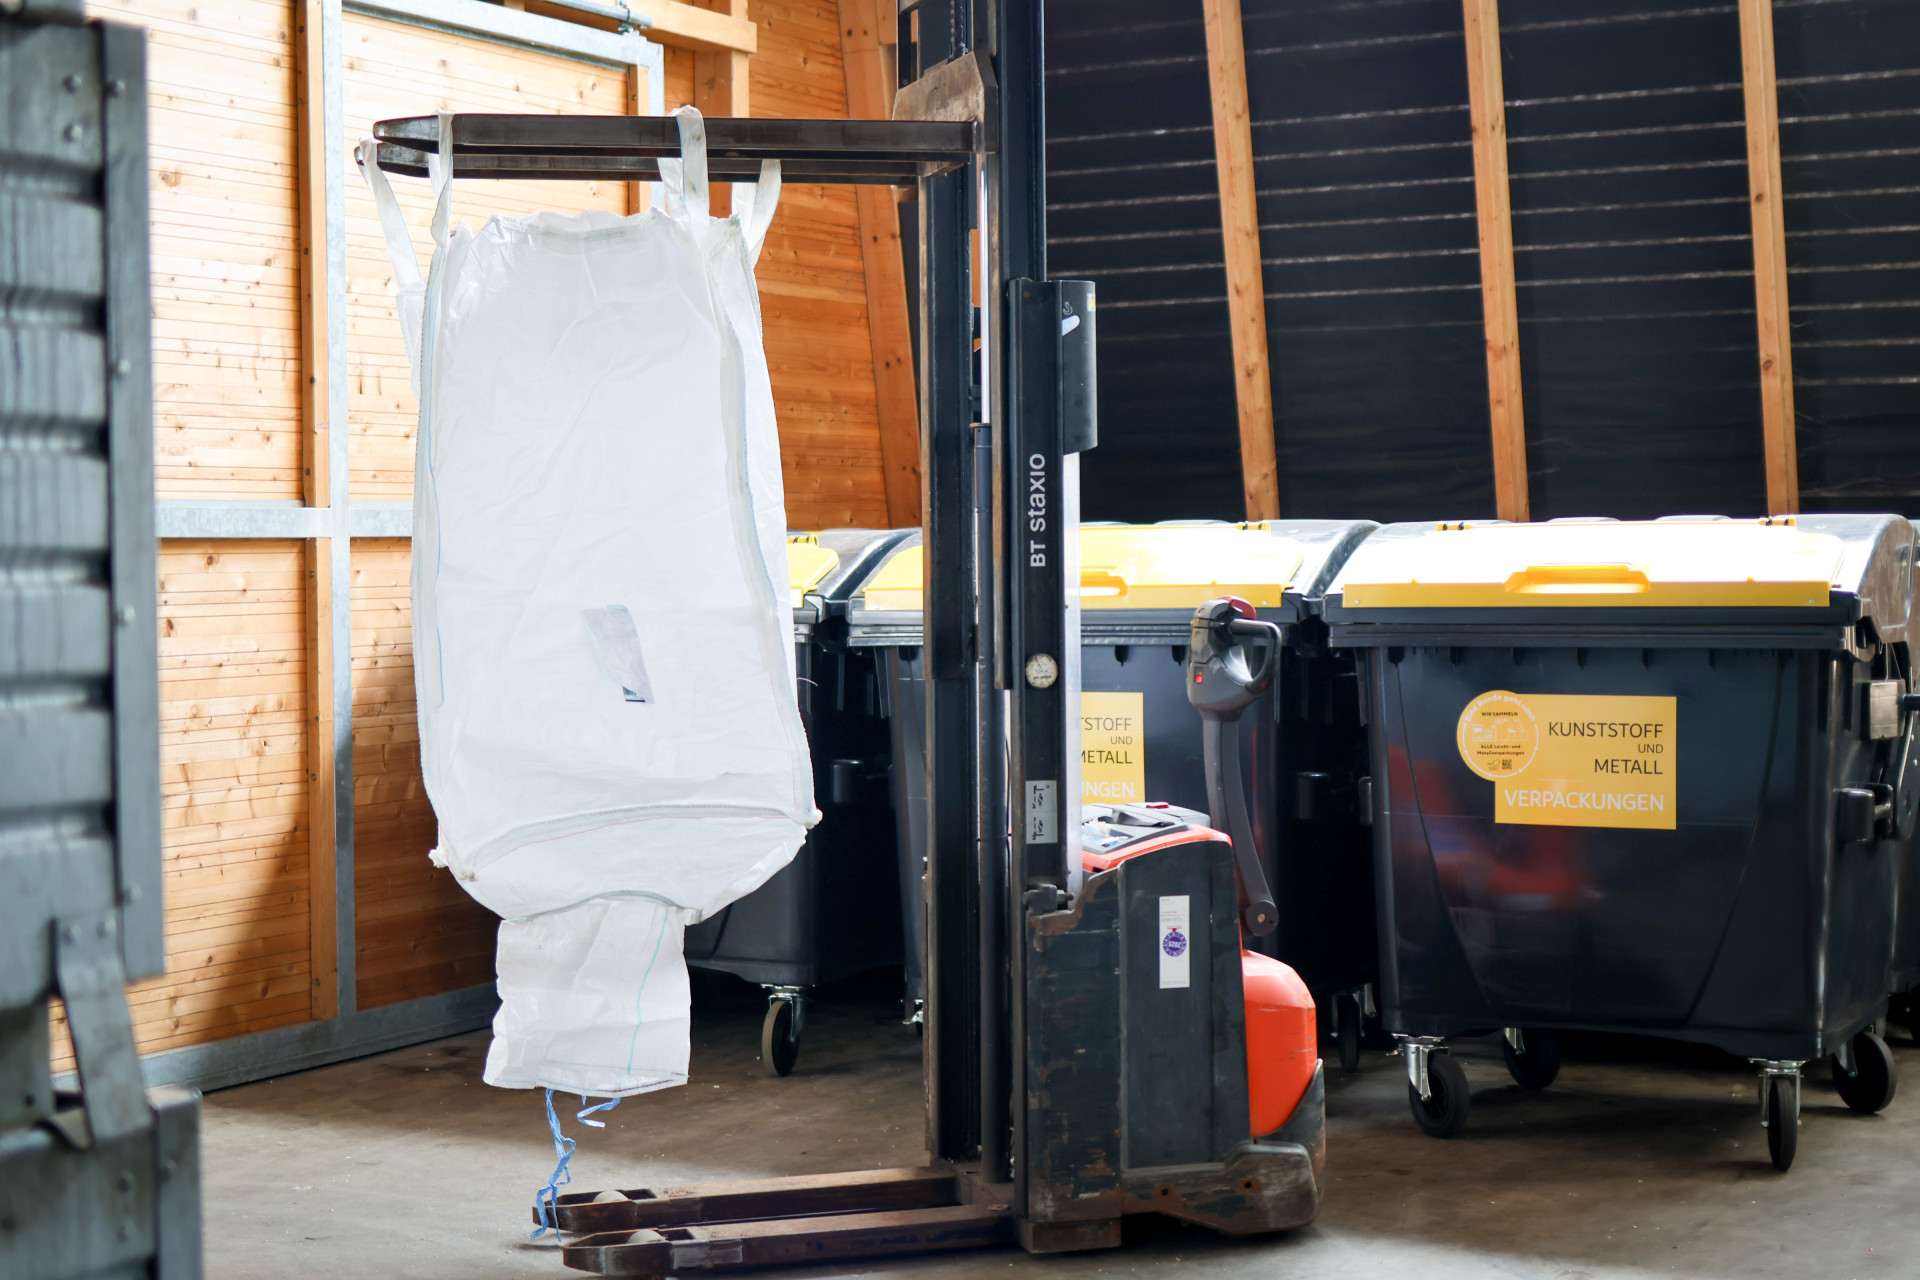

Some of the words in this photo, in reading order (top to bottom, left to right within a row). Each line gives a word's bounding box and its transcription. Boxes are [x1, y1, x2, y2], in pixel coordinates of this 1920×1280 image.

[1030, 540, 1046, 567] BT
[1549, 721, 1664, 739] KUNSTSTOFF
[1110, 735, 1133, 745] UND
[1637, 743, 1664, 754] UND
[1594, 758, 1663, 775] METALL
[1504, 789, 1664, 812] VERPACKUNGEN
